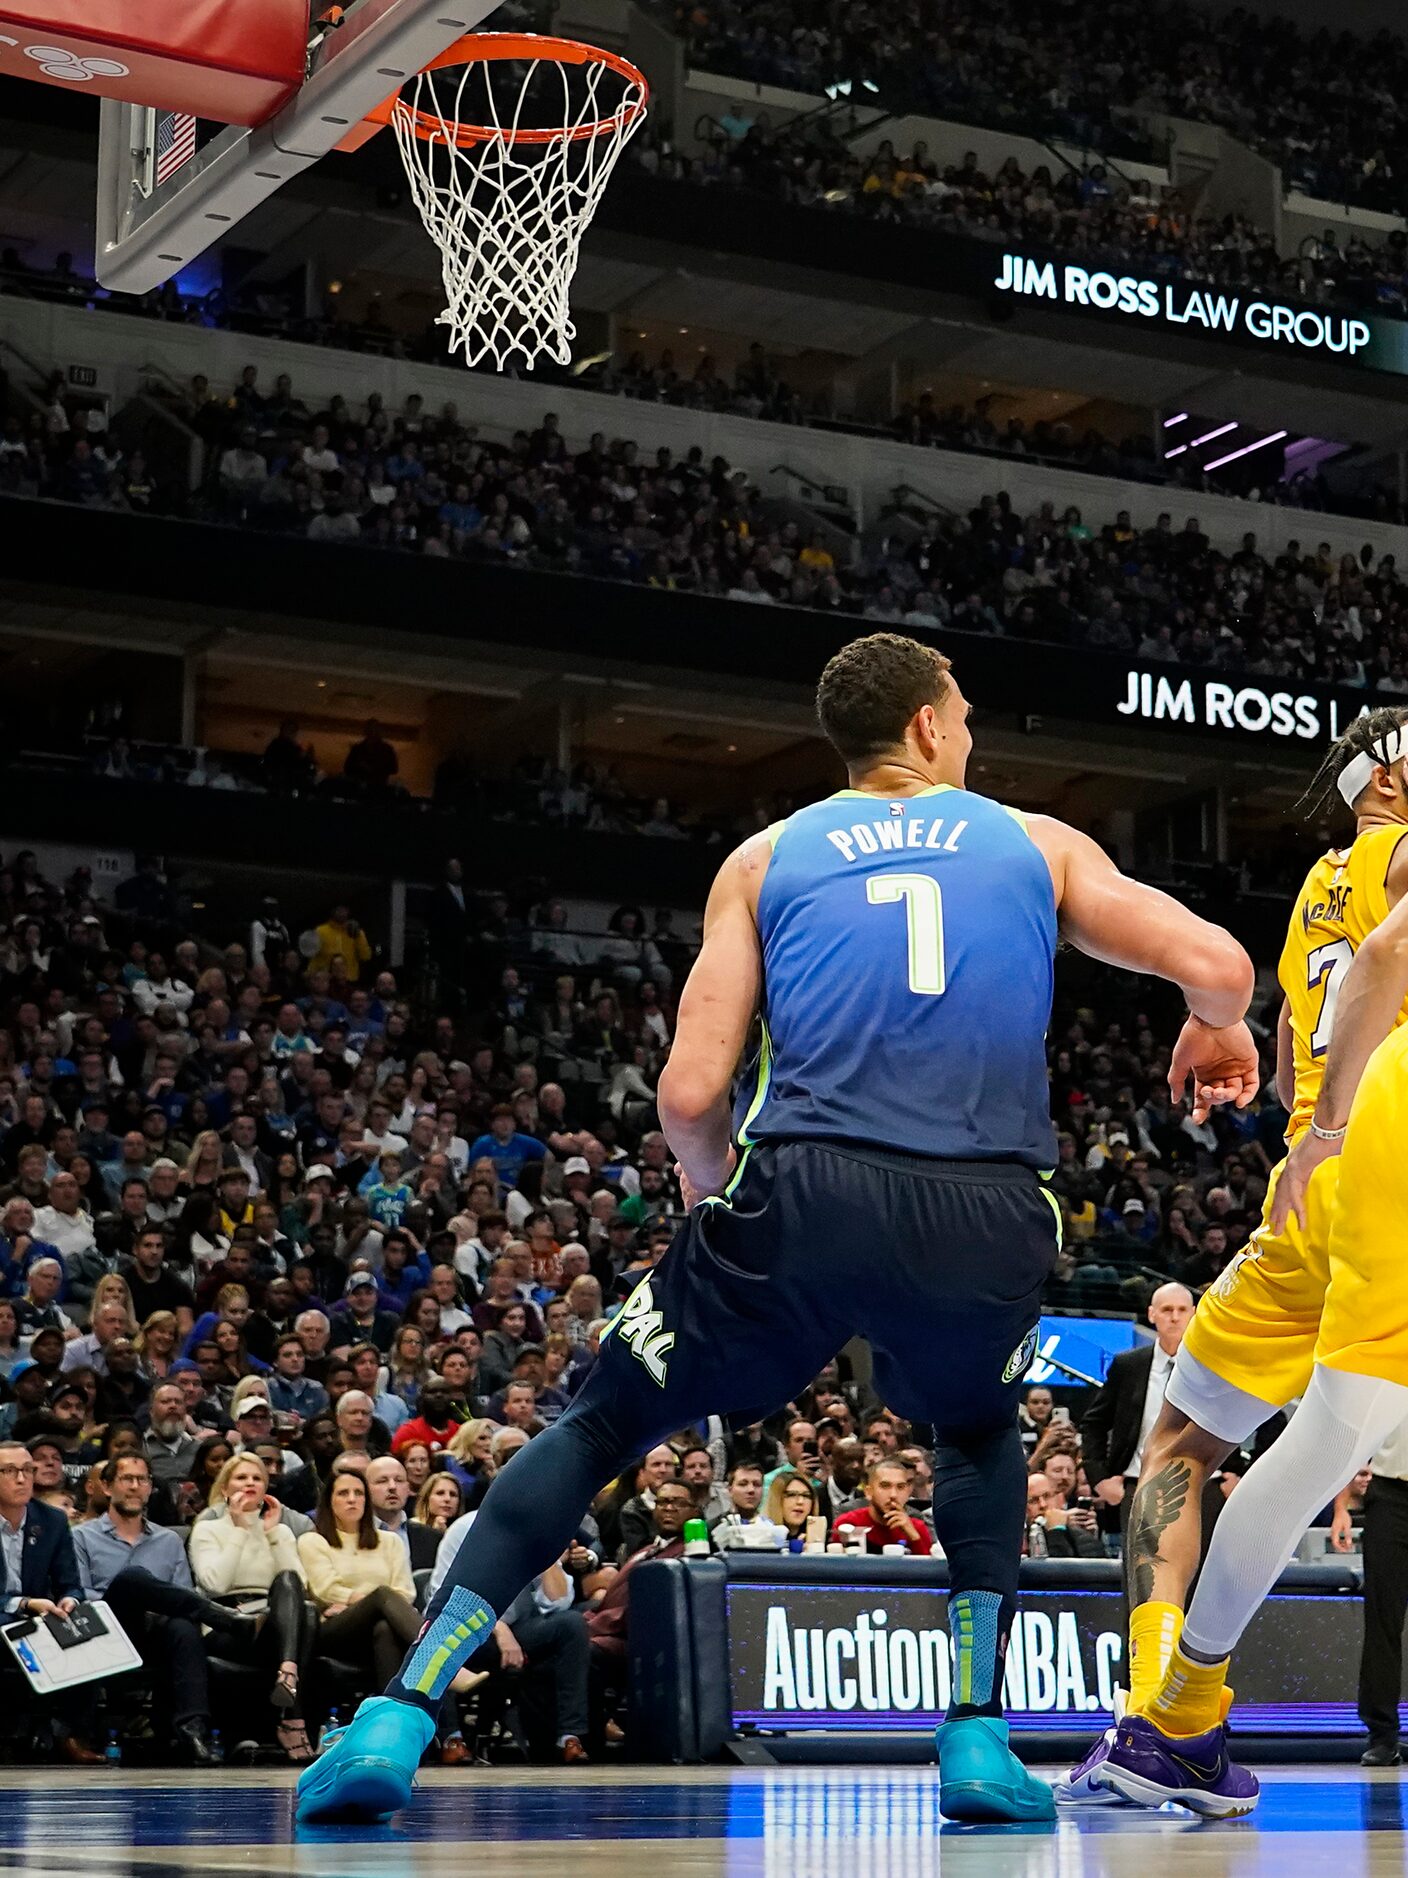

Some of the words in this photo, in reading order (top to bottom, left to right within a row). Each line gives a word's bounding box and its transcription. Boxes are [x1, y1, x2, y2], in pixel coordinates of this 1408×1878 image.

[995, 254, 1057, 299] JIM
[1063, 266, 1160, 317] ROSS
[1165, 284, 1239, 332] LAW
[1245, 302, 1370, 355] GROUP
[1116, 671, 1196, 724] JIM
[1205, 682, 1320, 739] ROSS
[826, 818, 970, 864] POWELL
[865, 872, 946, 996] 7
[618, 1280, 675, 1389] DAL
